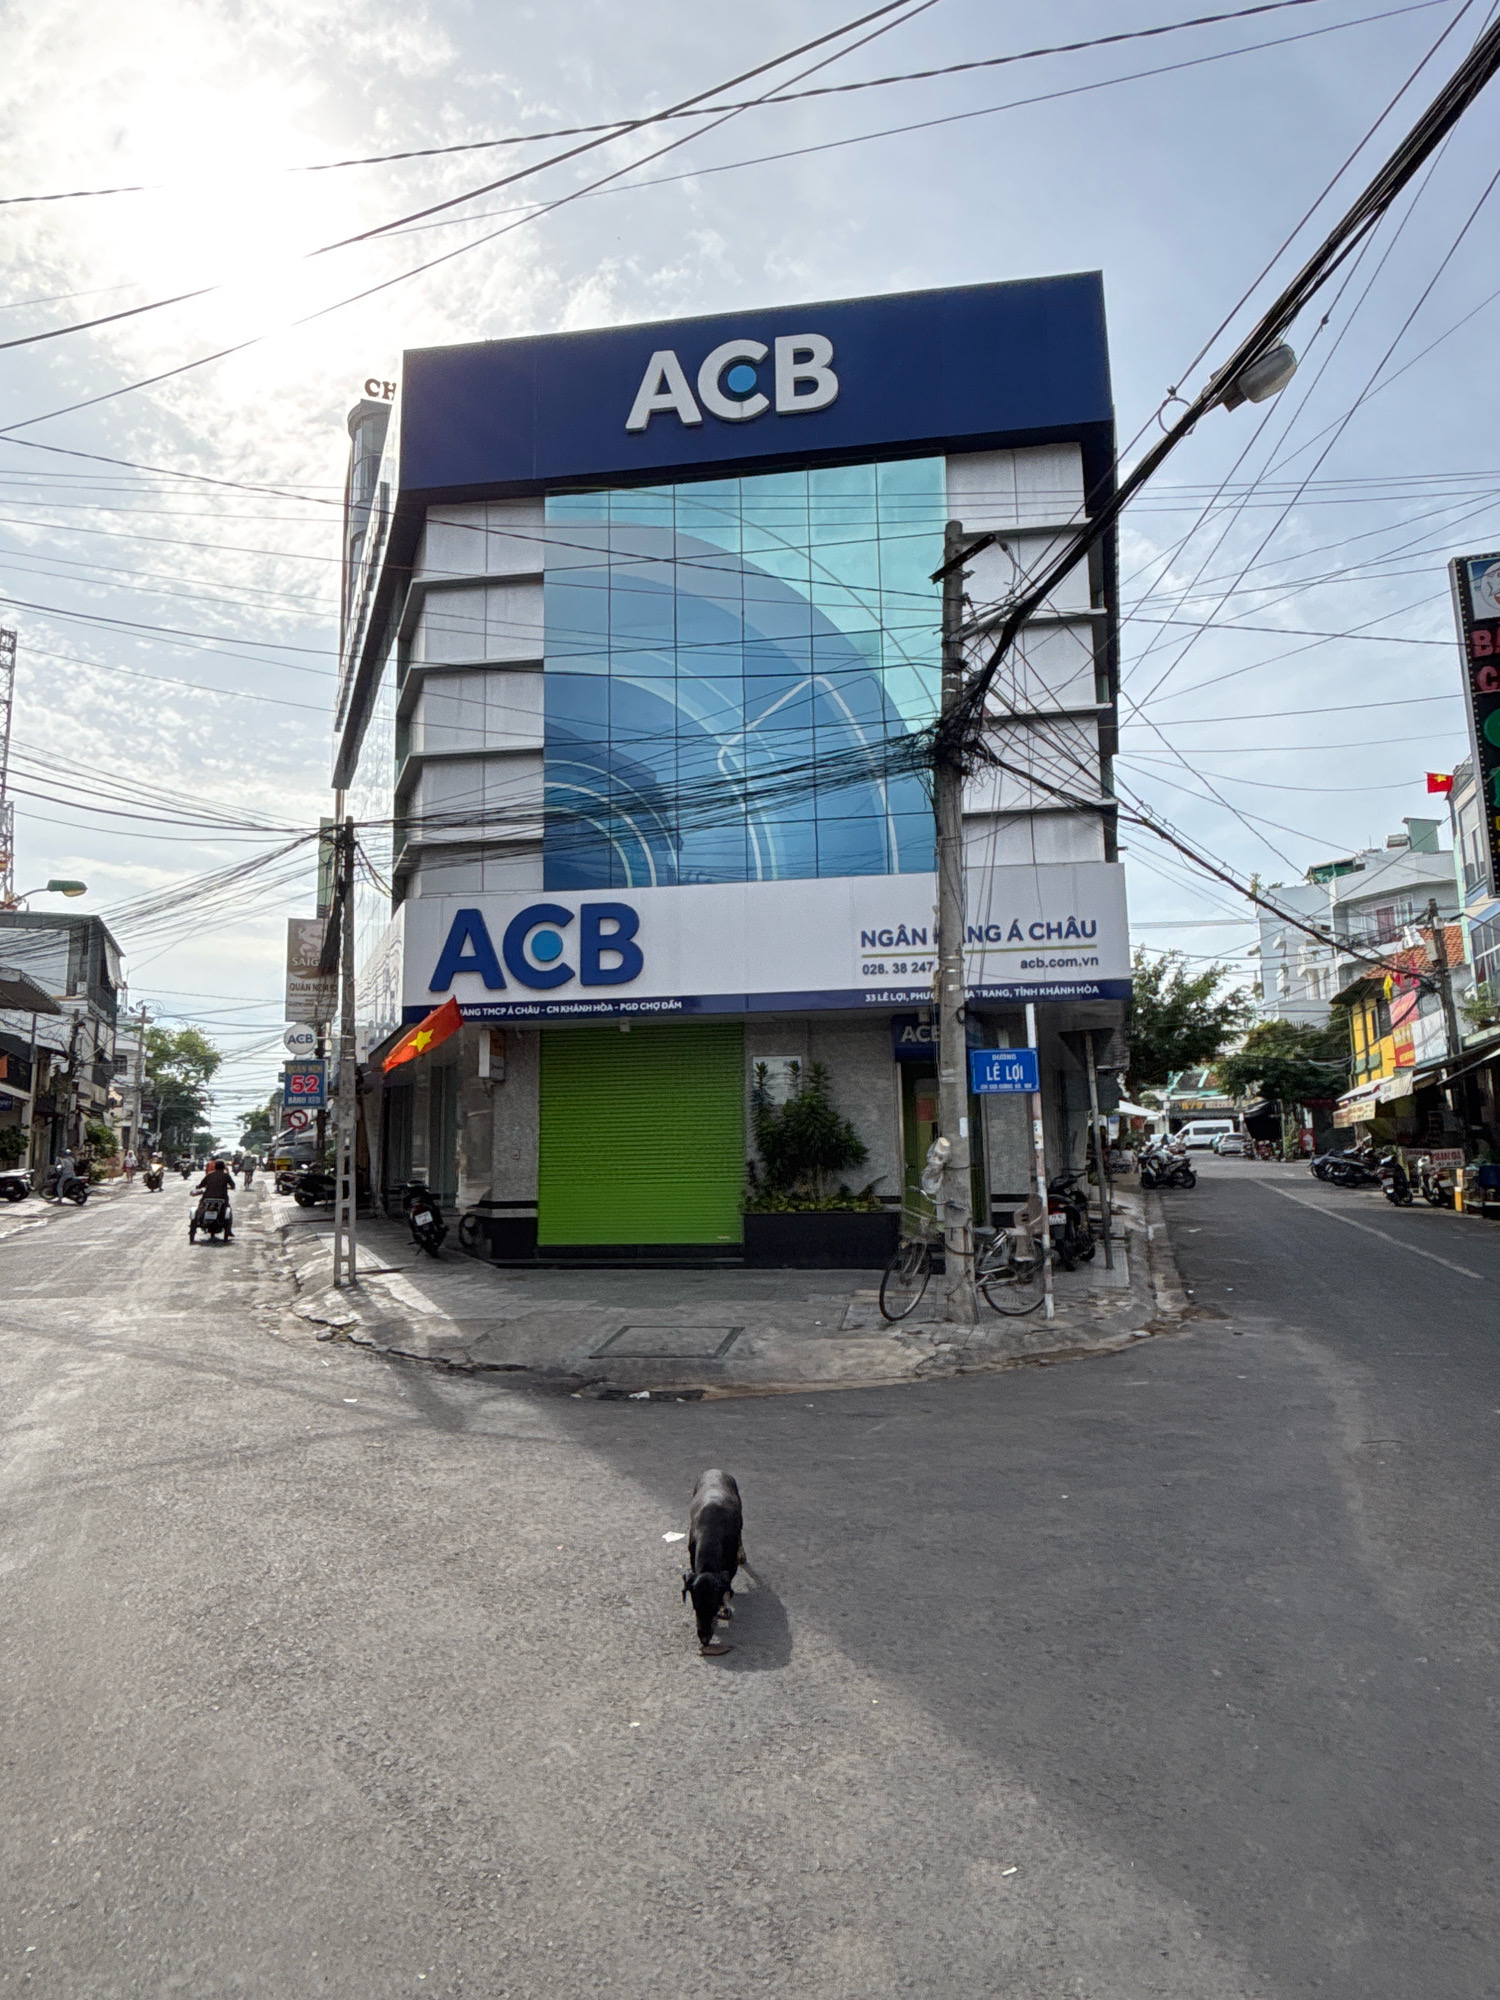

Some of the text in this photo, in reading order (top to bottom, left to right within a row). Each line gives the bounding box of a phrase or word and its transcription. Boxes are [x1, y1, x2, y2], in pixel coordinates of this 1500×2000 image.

[625, 333, 839, 432] ACB
[861, 924, 927, 948] NGÂN
[1007, 918, 1024, 942] Á
[1028, 915, 1097, 941] CHÂU
[428, 902, 644, 992] ACB
[892, 962, 908, 974] 38
[911, 961, 934, 973] 247
[1020, 956, 1099, 969] acb.com.vn
[865, 993, 876, 1003] 33
[877, 991, 889, 1002] LÊ
[1039, 984, 1075, 996] KHÁNH
[1077, 983, 1099, 994] HÒA
[482, 1007, 506, 1017] TMCP
[515, 1004, 540, 1015] CHÂU
[546, 1005, 560, 1014] CN
[560, 1003, 592, 1013] KHÁNH
[593, 1001, 613, 1012] HÒA
[619, 1002, 638, 1011] PGD
[640, 1001, 660, 1011] CHỢ
[287, 1034, 313, 1045] ACB
[986, 1061, 1024, 1082] LÊ LỢI
[290, 1075, 320, 1094] 52
